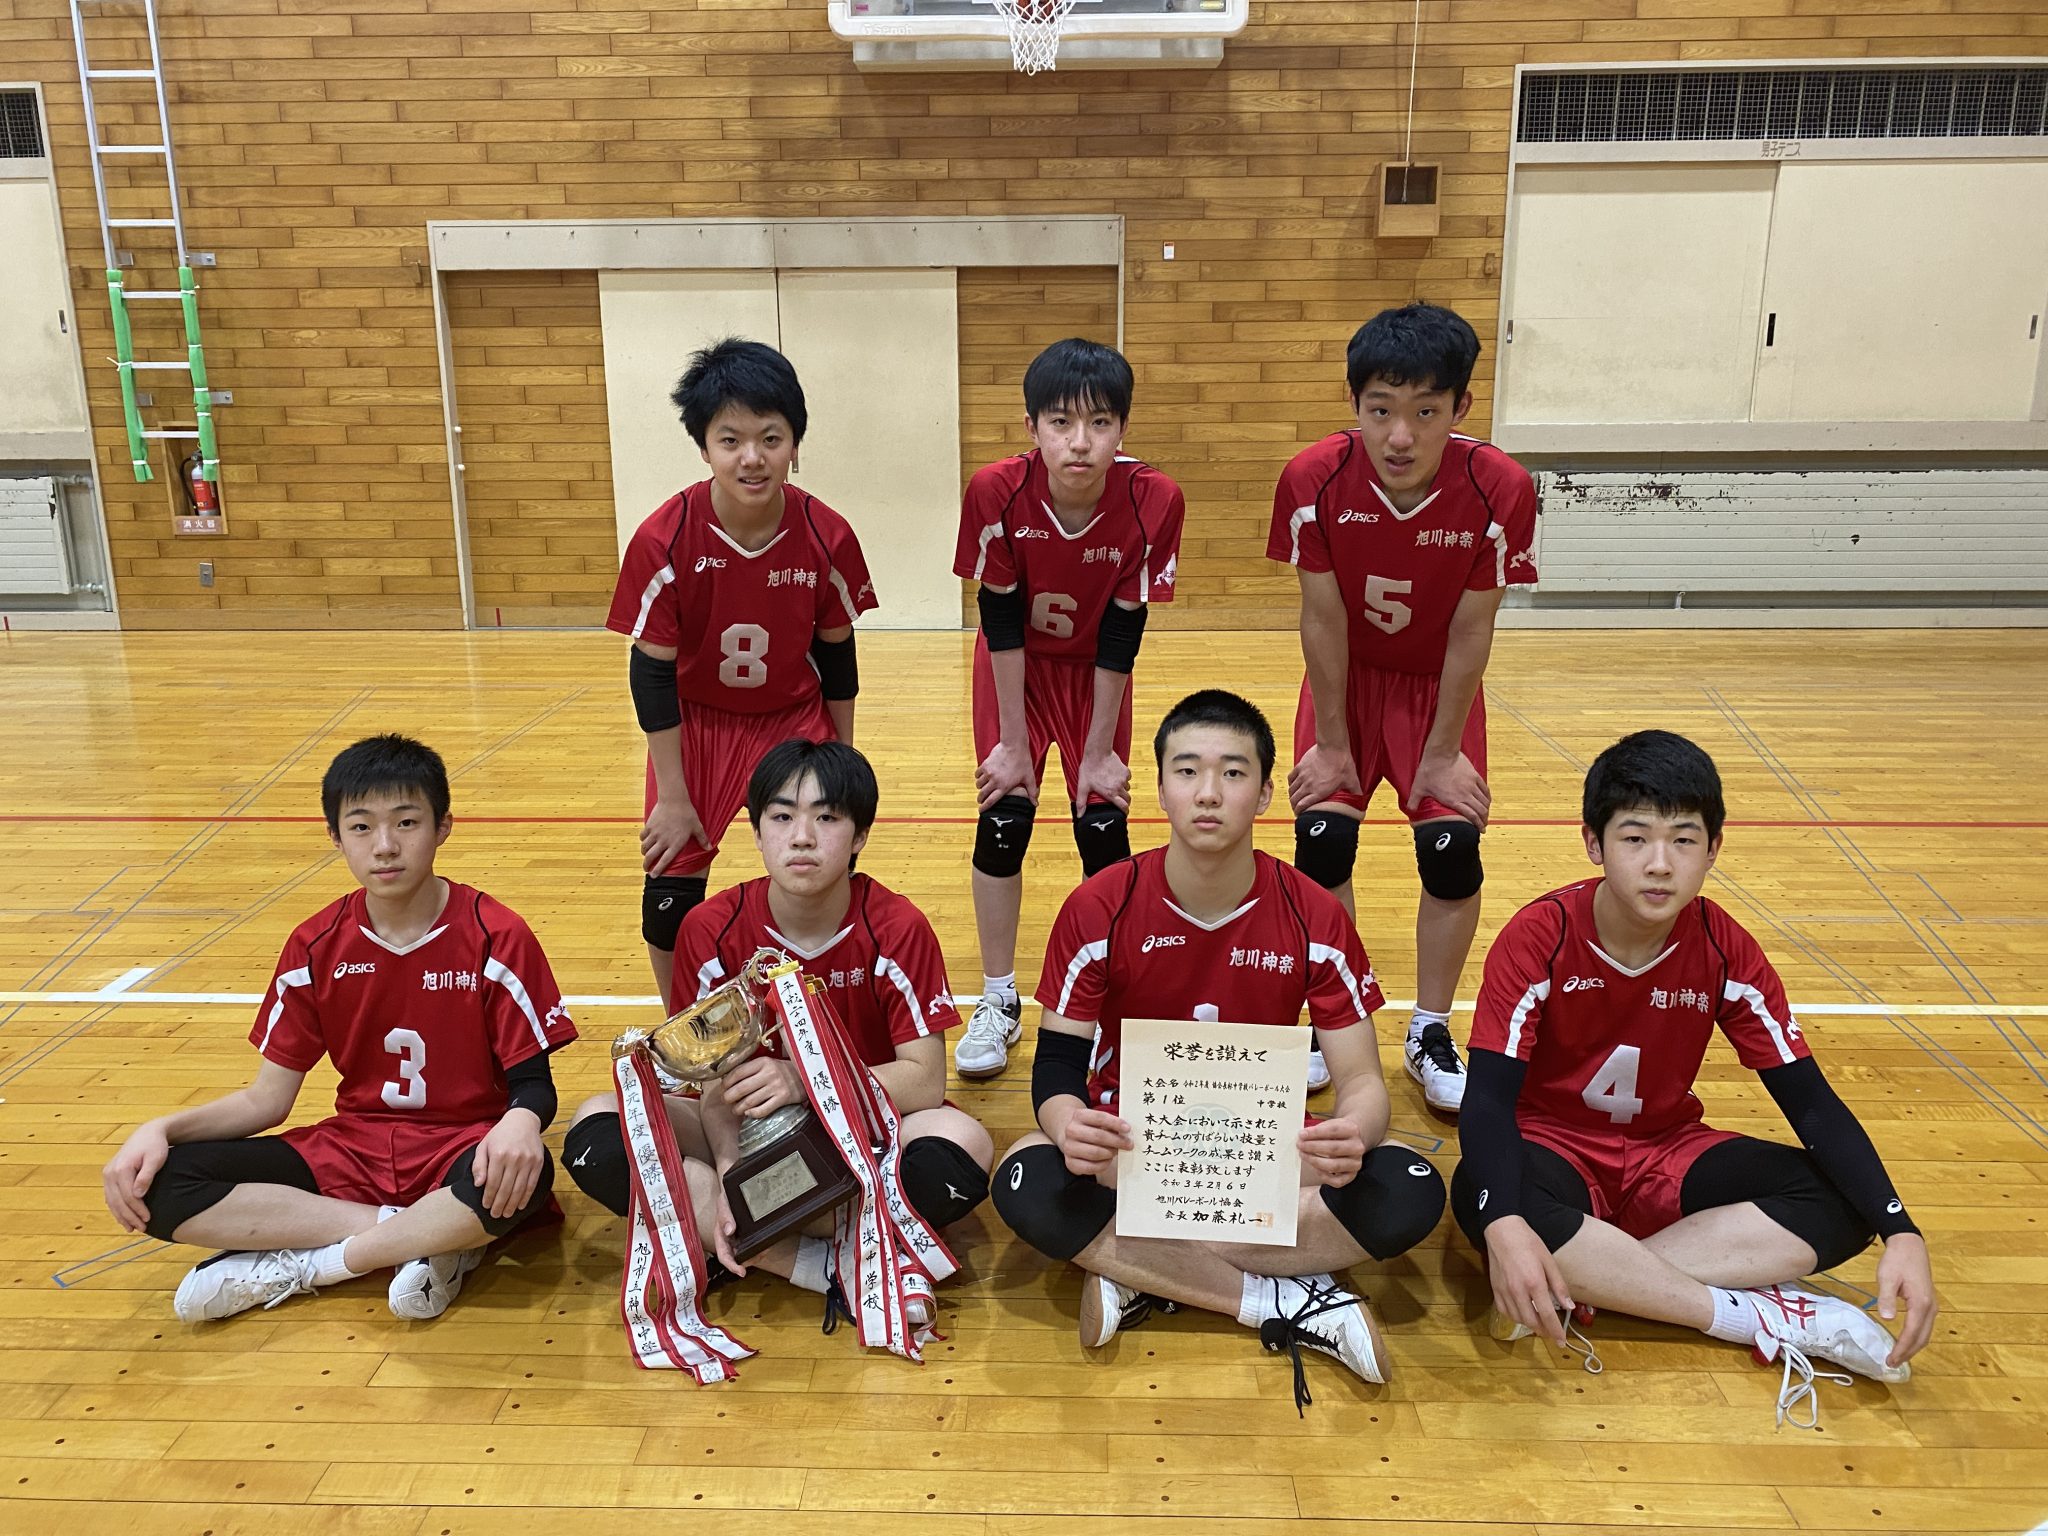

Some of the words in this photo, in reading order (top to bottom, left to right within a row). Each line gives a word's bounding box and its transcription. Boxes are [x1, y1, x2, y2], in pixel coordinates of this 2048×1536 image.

[1761, 141, 1801, 157] 男子テニス
[1415, 529, 1474, 549] 旭川神楽
[767, 568, 817, 589] 旭川神楽
[1364, 574, 1412, 635] 5
[1030, 591, 1078, 639] 6
[719, 623, 769, 688] 8
[1155, 935, 1186, 948] asics
[348, 962, 375, 974] asics
[1229, 946, 1295, 975] 旭川神楽
[1650, 986, 1709, 1013] 旭川神楽
[1163, 1041, 1269, 1063] 栄誉を讃えて
[381, 1027, 426, 1109] 3
[1142, 1077, 1180, 1089] 大会名
[1582, 1044, 1643, 1124] 4
[619, 1061, 650, 1141] 令和元年度
[1142, 1091, 1187, 1106] 第1位
[1256, 1099, 1288, 1110] 中学校
[1144, 1112, 1279, 1130] 本大会において示された
[1144, 1160, 1256, 1178] ここに表彰致します
[1160, 1178, 1248, 1190] 令和3年2月6日
[1155, 1194, 1245, 1208] 旭川バレーボール協会
[1164, 1209, 1188, 1221] 会長
